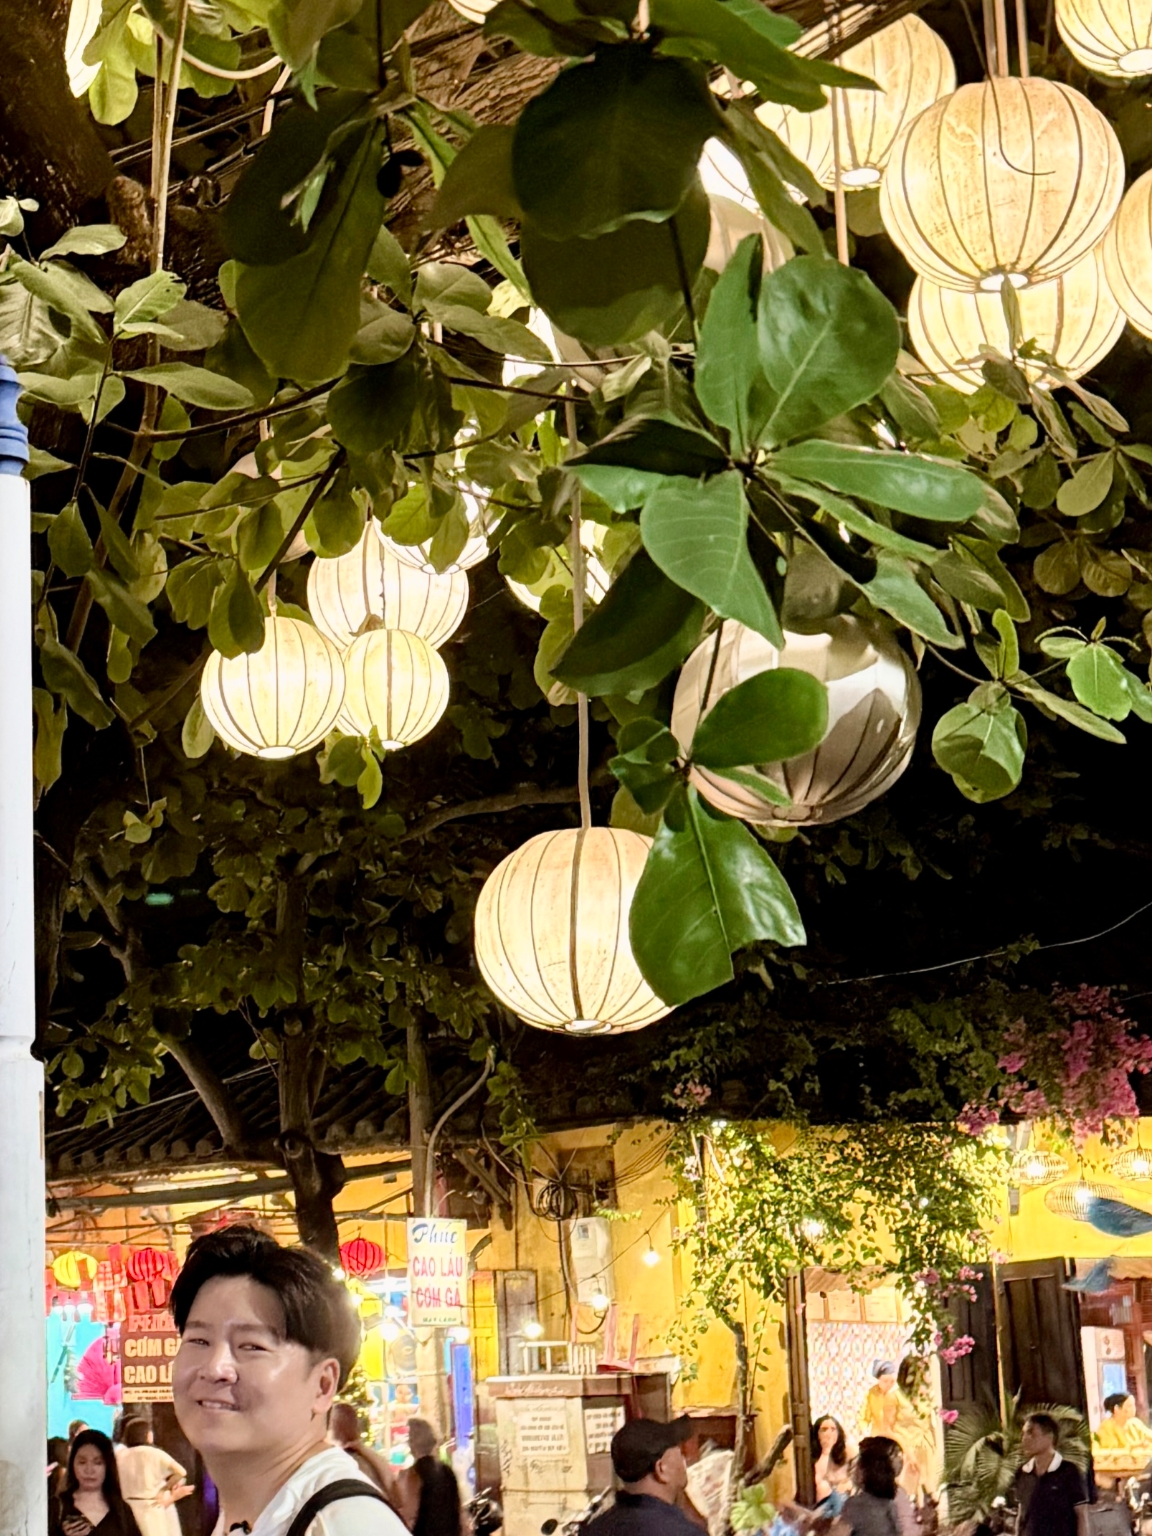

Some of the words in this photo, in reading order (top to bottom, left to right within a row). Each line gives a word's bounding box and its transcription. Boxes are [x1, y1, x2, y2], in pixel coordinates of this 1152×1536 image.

[413, 1256, 436, 1277] CAO
[445, 1281, 461, 1307] GÀ
[125, 1336, 162, 1358] CƠM
[124, 1365, 157, 1385] CAO
